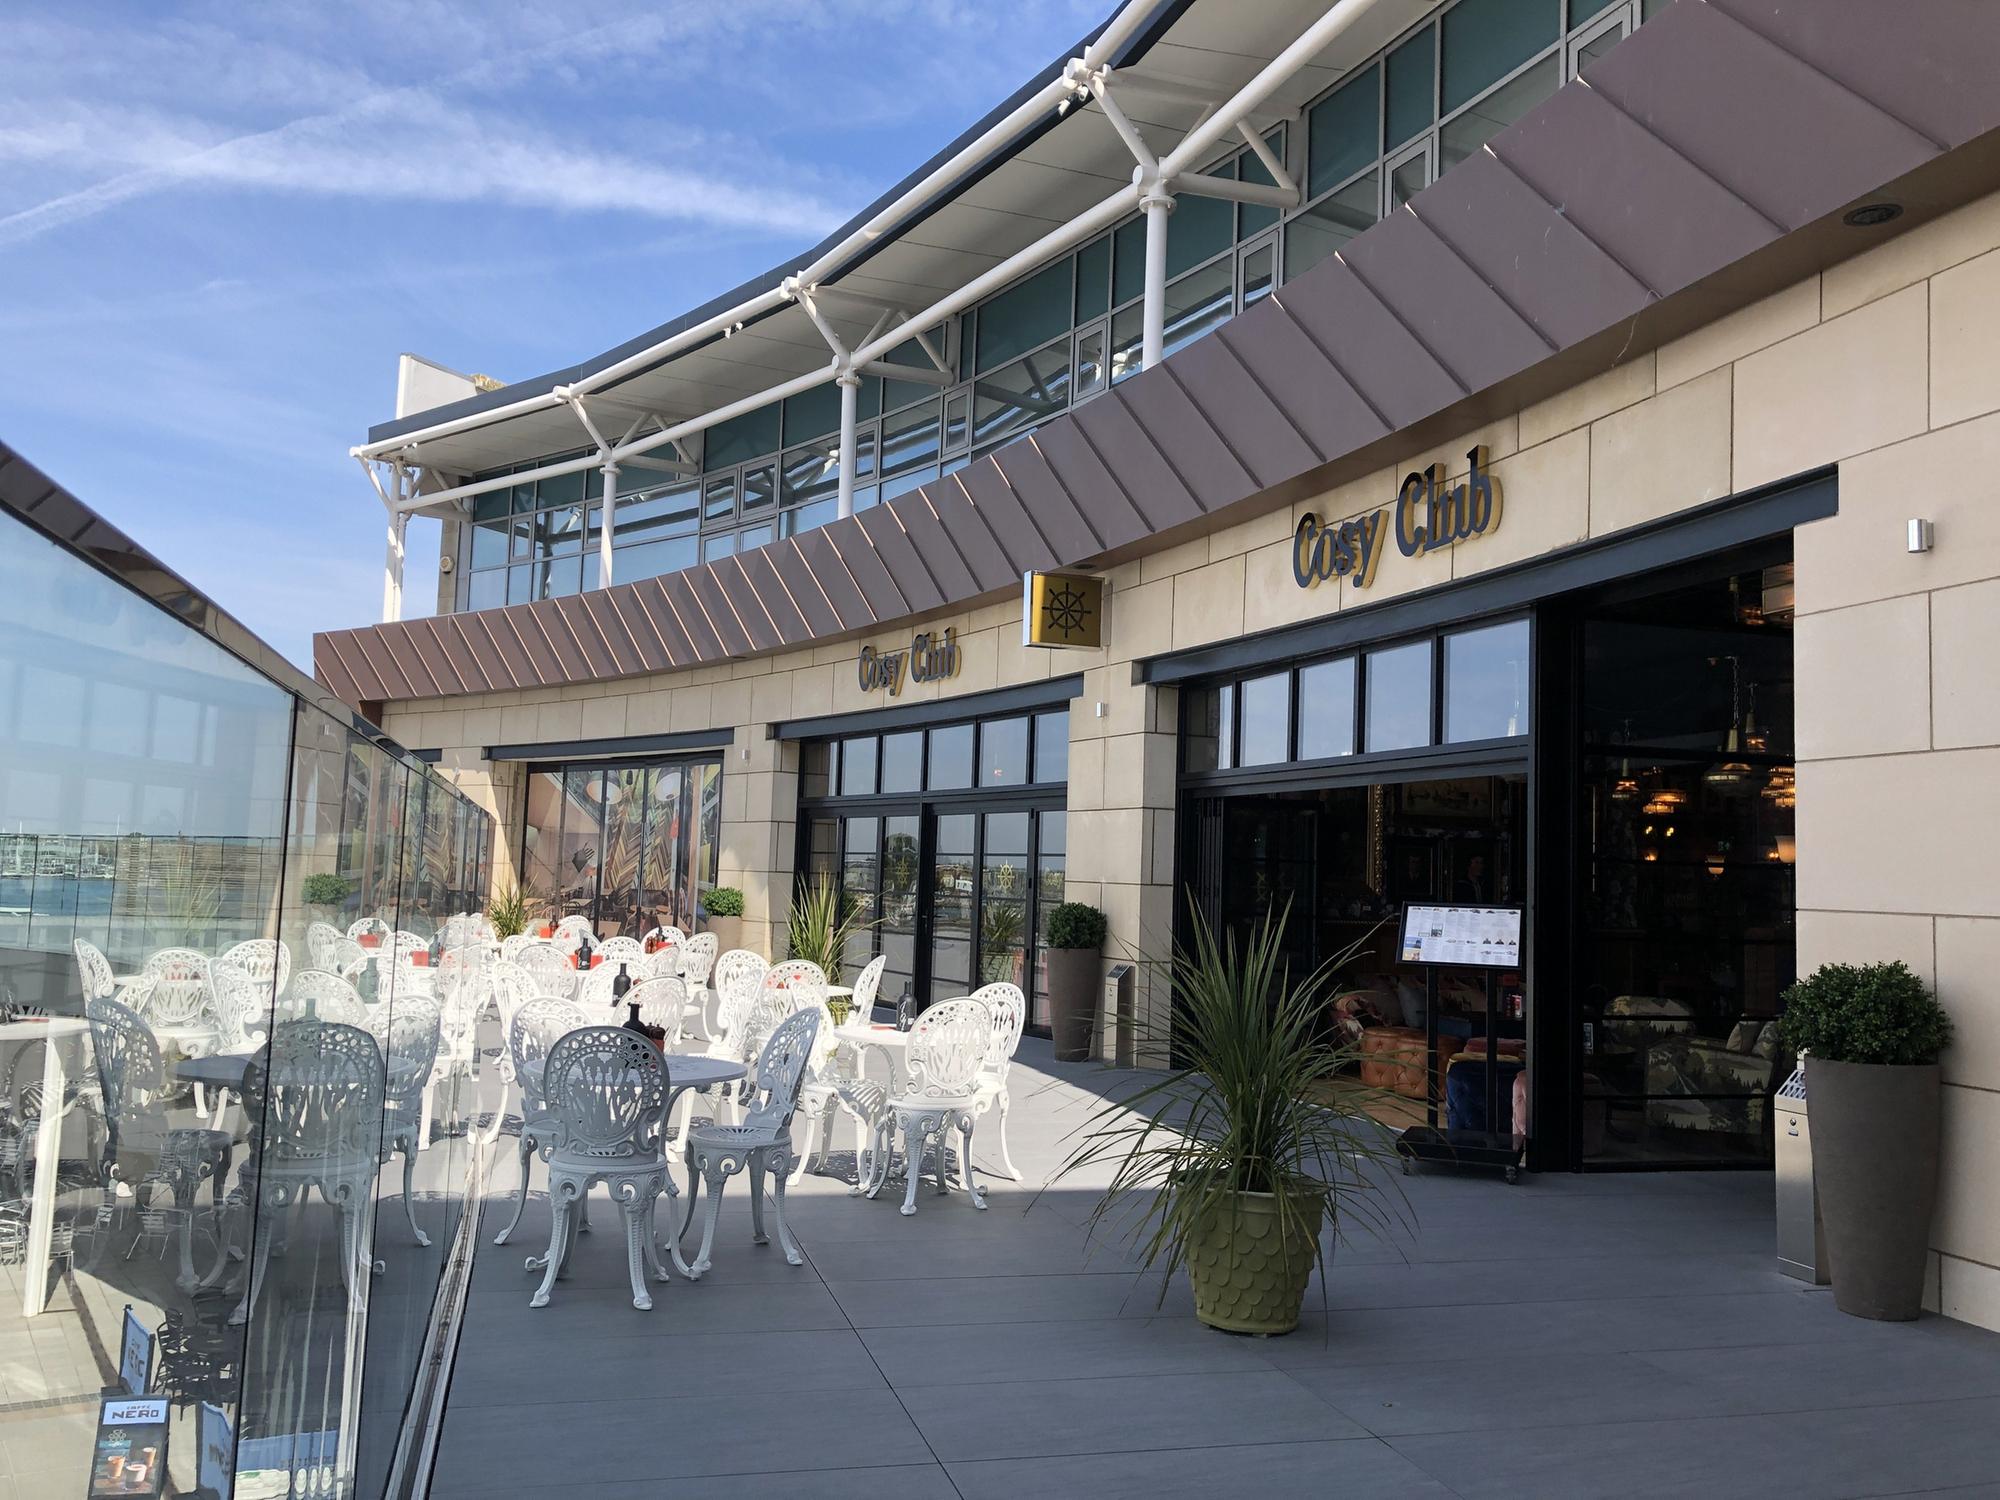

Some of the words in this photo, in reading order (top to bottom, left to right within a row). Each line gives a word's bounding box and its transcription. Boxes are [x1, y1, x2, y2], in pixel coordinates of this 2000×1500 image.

[1293, 511, 1388, 589] Cosy
[1394, 444, 1502, 558] Club
[858, 645, 909, 697] Cosy
[910, 627, 962, 684] Club
[111, 1409, 160, 1419] NERO
